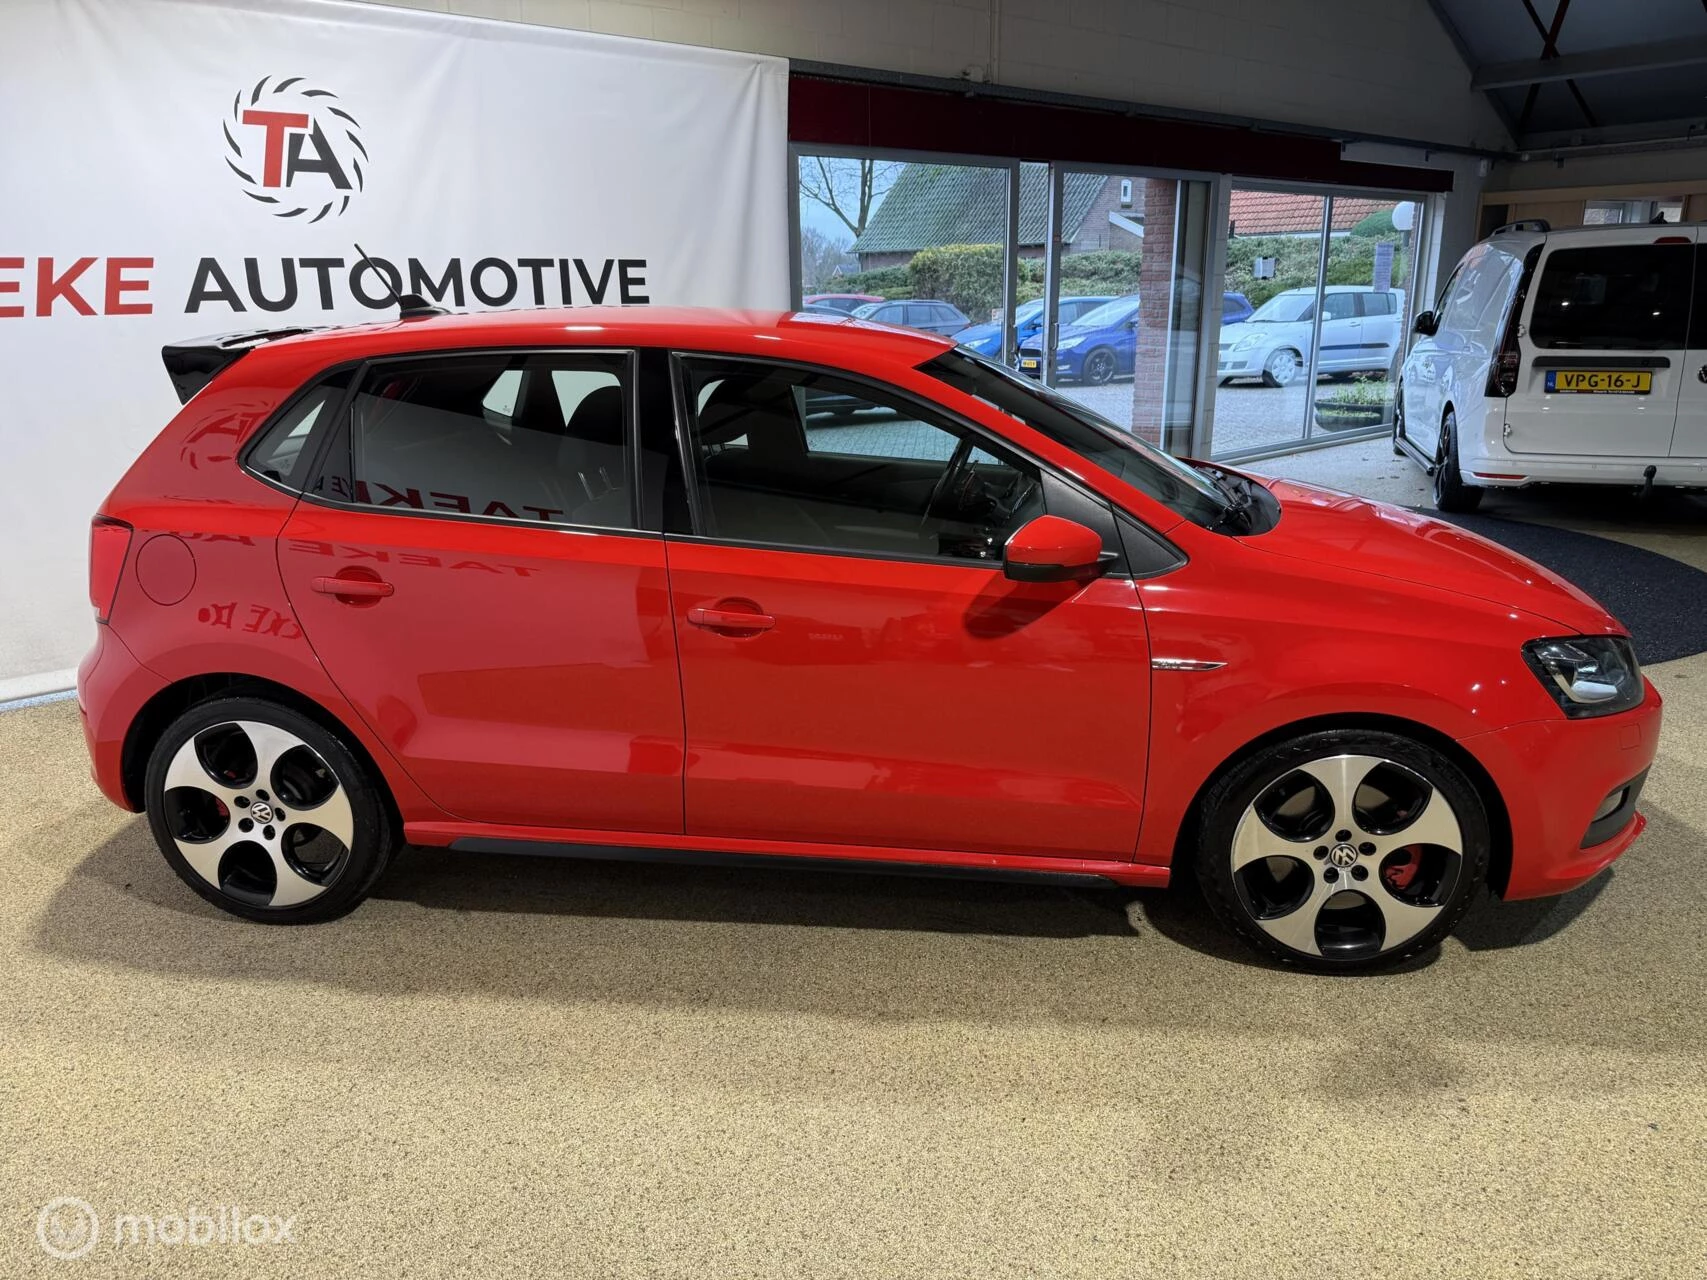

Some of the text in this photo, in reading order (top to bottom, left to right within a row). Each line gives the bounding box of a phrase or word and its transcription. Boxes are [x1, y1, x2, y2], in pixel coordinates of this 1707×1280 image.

[242, 109, 353, 190] TA
[184, 256, 650, 313] AUTOMOTIVE
[1564, 374, 1641, 388] VPG-16-J
